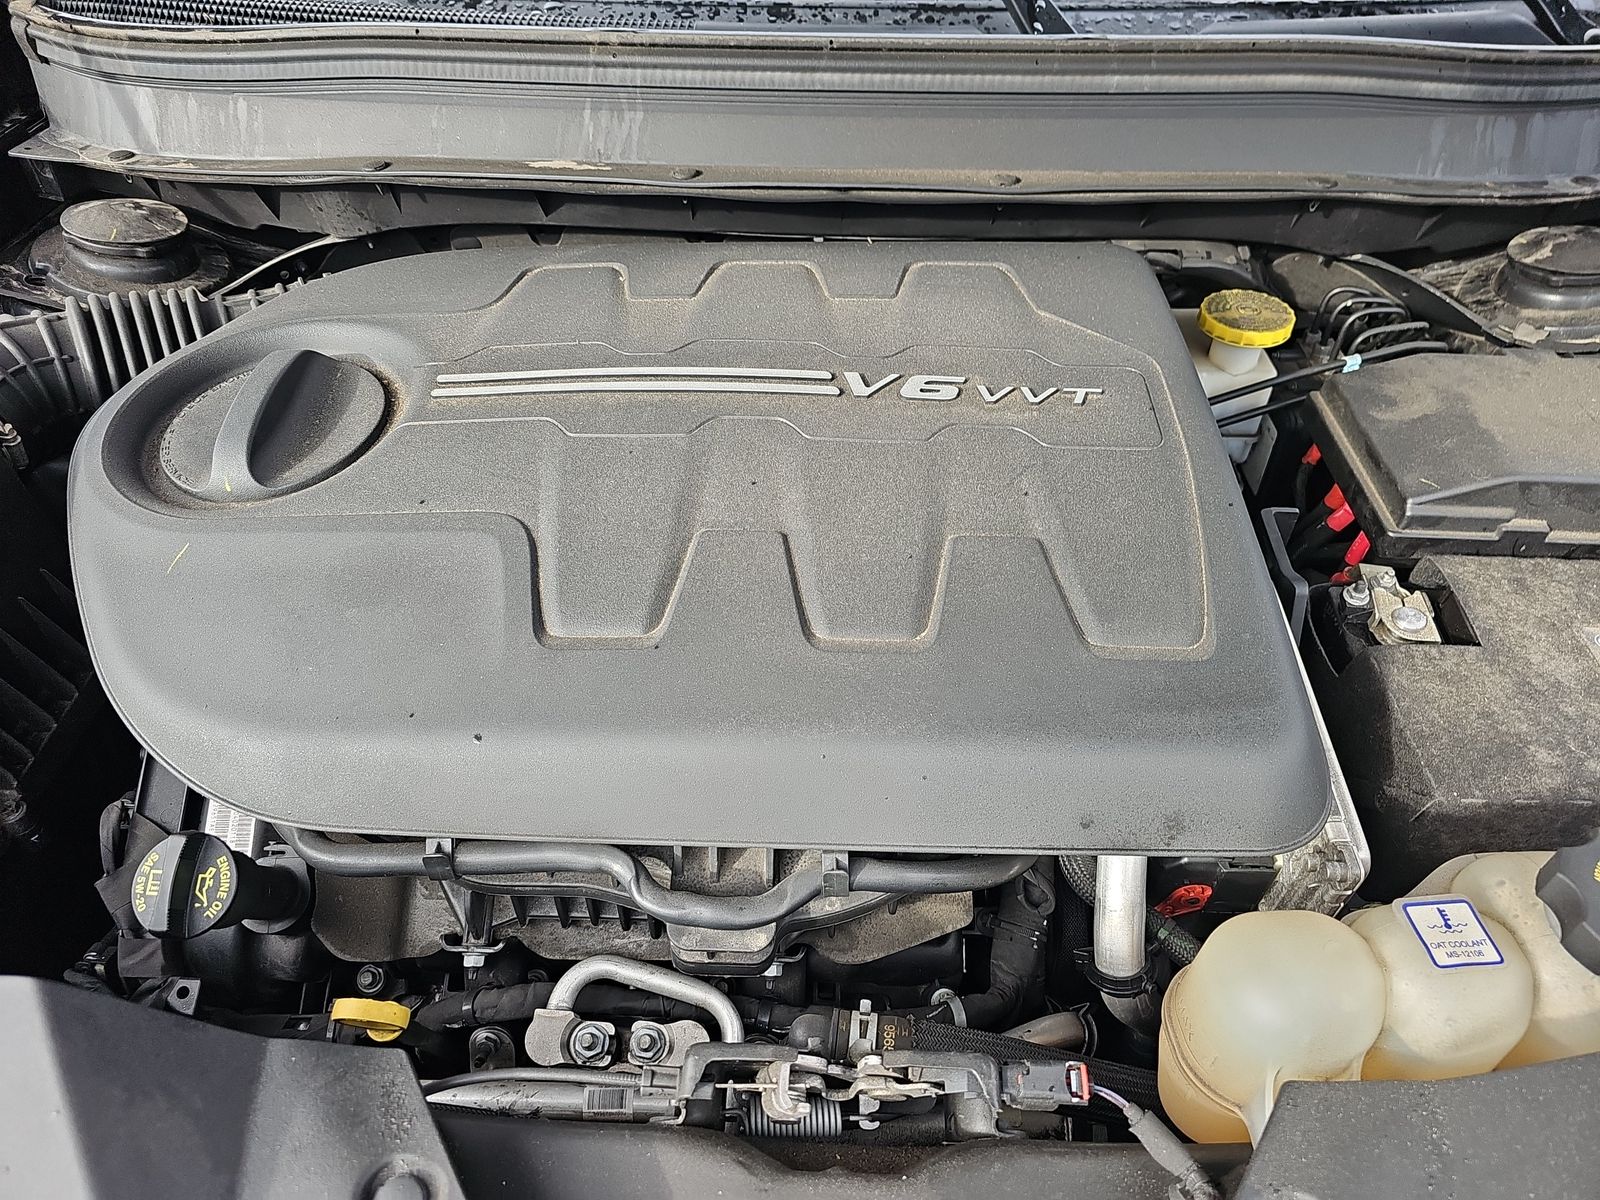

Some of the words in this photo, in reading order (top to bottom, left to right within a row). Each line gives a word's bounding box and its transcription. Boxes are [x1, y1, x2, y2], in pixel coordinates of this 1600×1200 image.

[843, 371, 966, 401] V6
[976, 385, 1103, 405] VVT
[141, 852, 160, 875] SAE
[216, 855, 231, 900] ENGINE
[134, 876, 147, 913] 5W-20
[203, 901, 223, 919] OIL
[1430, 941, 1447, 949] OAT
[1448, 939, 1488, 948] COOLANT
[1445, 950, 1485, 958] MS-12106
